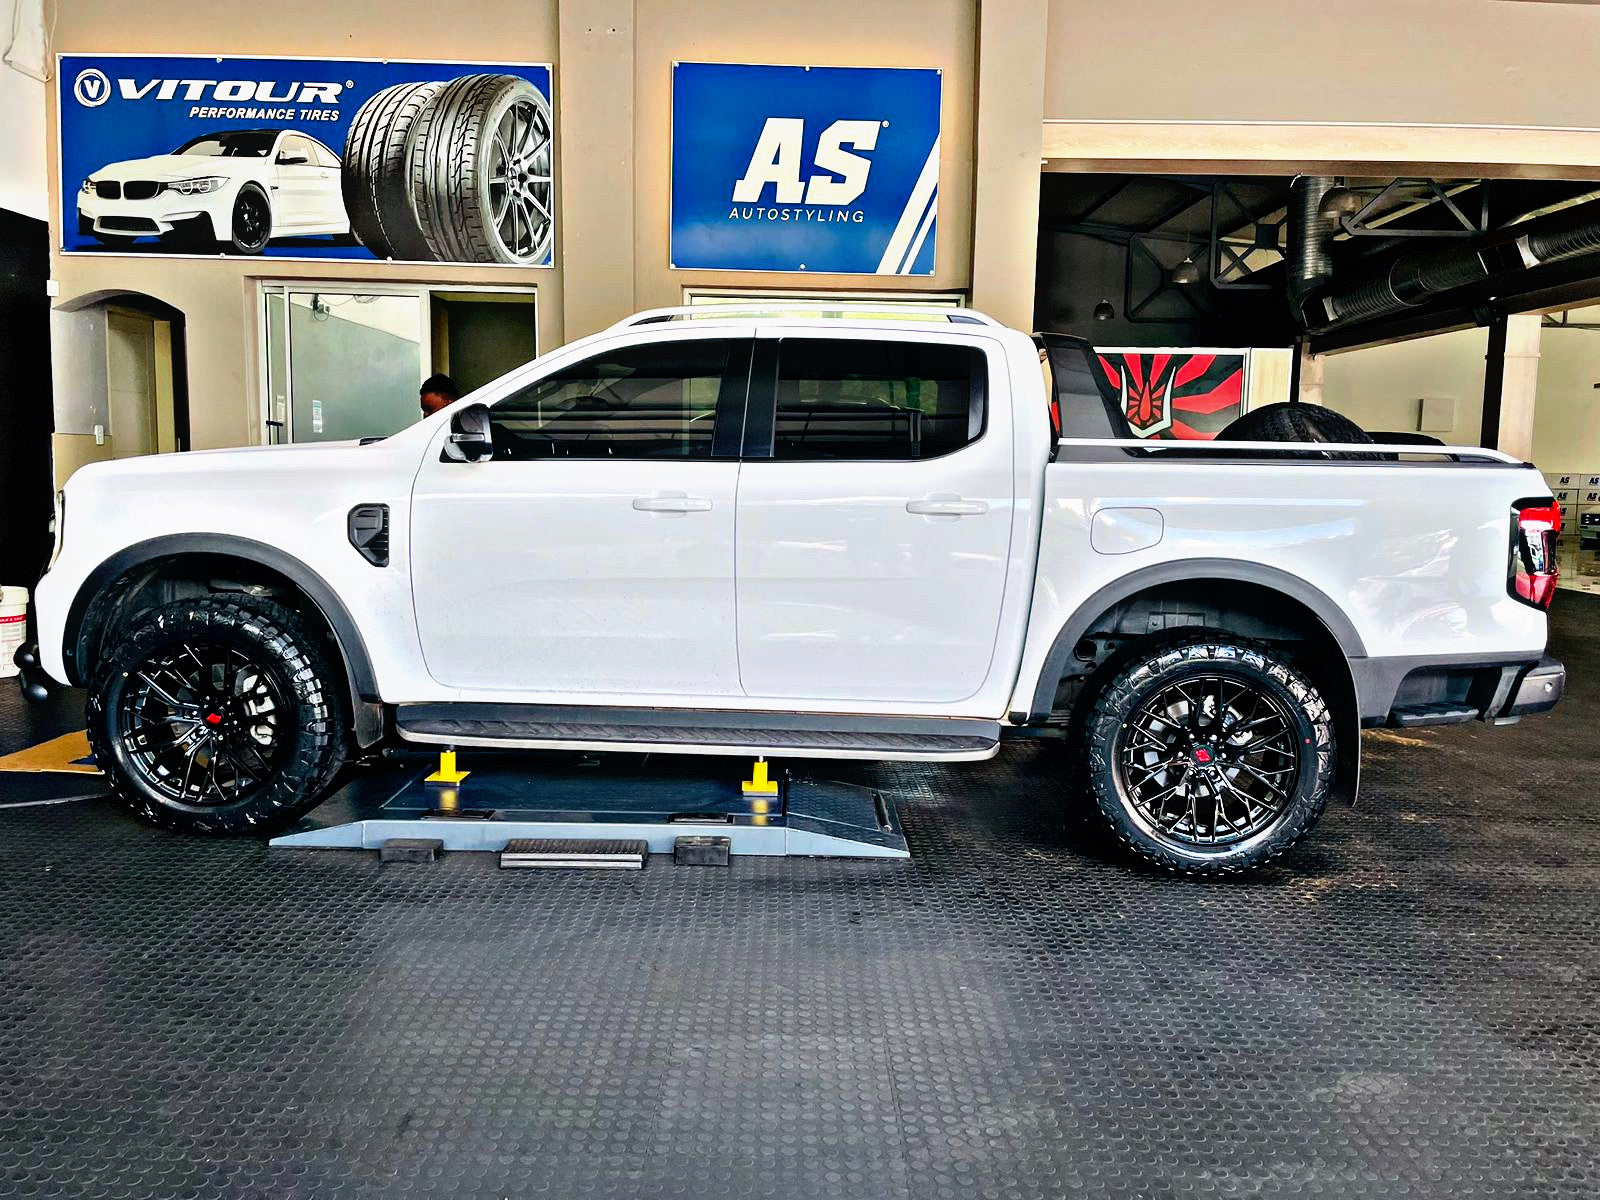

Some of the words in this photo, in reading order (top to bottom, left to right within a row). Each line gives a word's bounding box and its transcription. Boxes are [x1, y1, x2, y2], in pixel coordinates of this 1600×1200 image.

[118, 78, 343, 104] VITOUR
[189, 106, 296, 120] PERFORMANCE
[300, 109, 340, 122] TIRES
[732, 117, 881, 206] AS
[728, 207, 864, 223] AUTOSTYLING
[1560, 476, 1570, 484] AS
[1557, 492, 1567, 500] AS
[1587, 492, 1597, 500] AS
